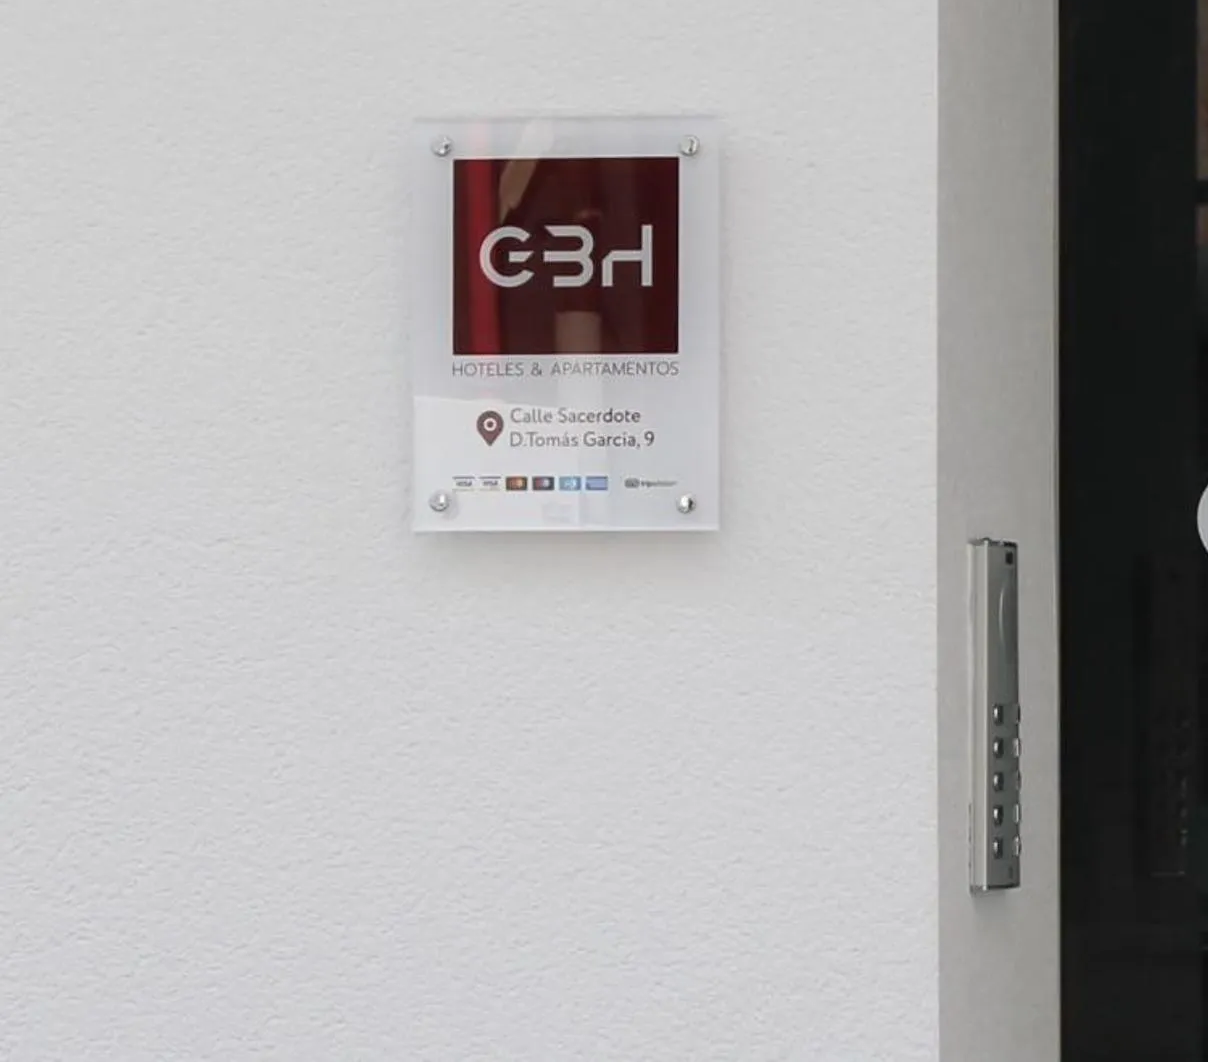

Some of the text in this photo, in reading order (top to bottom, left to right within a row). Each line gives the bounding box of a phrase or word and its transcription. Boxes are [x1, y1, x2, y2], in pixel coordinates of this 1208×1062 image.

[479, 224, 654, 288] GBH
[452, 361, 680, 377] HOTELES & APARTAMENTOS
[510, 408, 641, 424] Calle Sacerdote
[644, 431, 655, 446] 9
